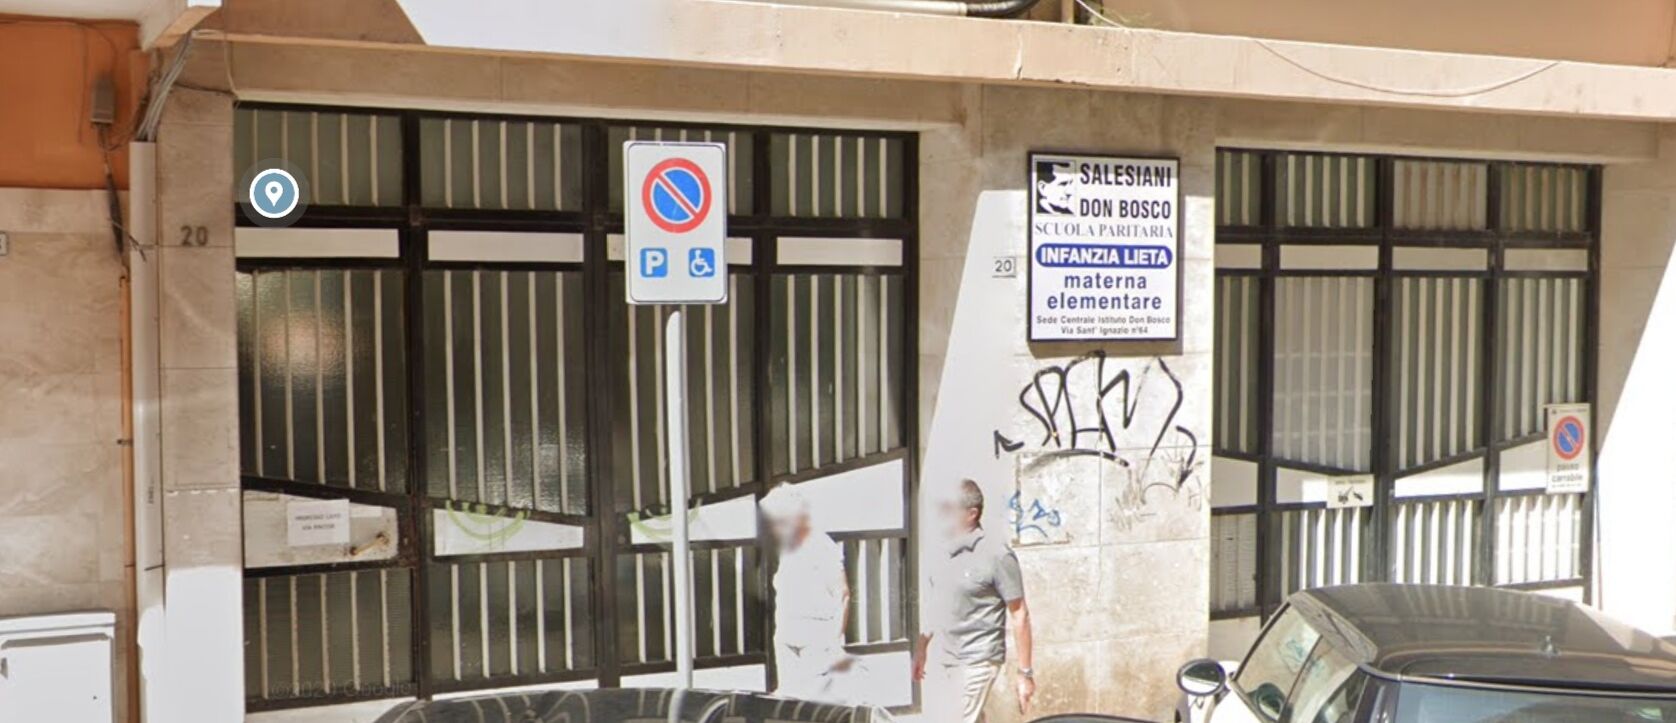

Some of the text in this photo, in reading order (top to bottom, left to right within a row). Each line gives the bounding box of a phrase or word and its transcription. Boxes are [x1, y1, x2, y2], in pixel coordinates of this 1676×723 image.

[1080, 163, 1171, 187] SALESIANI
[1080, 199, 1171, 219] DON BOSCO
[180, 225, 208, 246] 20
[1035, 222, 1173, 238] SCUOLA PARITARIA
[645, 250, 665, 275] P
[1041, 247, 1169, 265] INFANZIA LIETA
[995, 259, 1012, 272] 20
[1064, 272, 1147, 289] materna
[1047, 292, 1162, 310] elementare
[1036, 315, 1171, 324] Sede Centrale Istituto Don Bosco
[1061, 326, 1074, 334] Via
[1100, 326, 1129, 336] Ignazio
